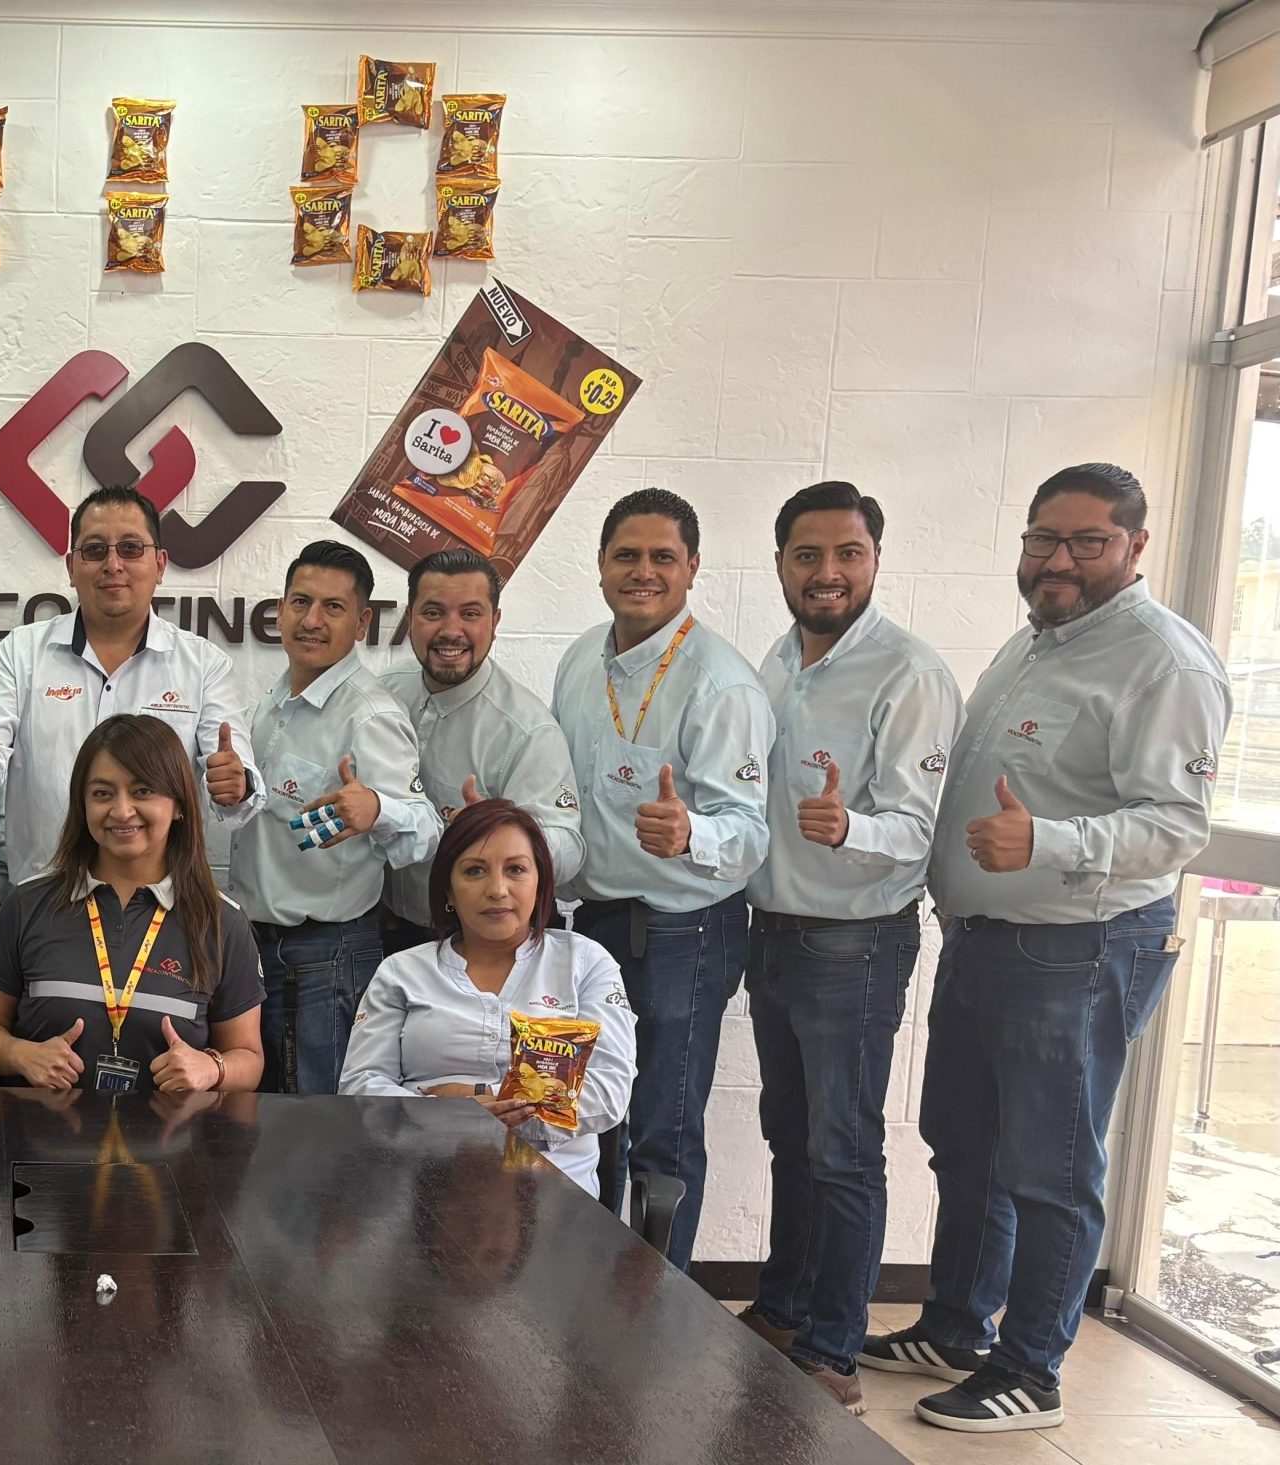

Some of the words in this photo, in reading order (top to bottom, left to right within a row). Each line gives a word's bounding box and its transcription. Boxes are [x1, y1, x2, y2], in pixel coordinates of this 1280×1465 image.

[375, 72, 388, 112] SARITA
[125, 115, 160, 127] SARITA
[318, 116, 351, 127] SARITA
[455, 110, 491, 122] SARITA
[305, 200, 341, 212] SARITA
[451, 195, 487, 207] SARITA
[119, 208, 154, 219] SARITA
[372, 240, 385, 279] SARITA
[487, 286, 517, 327] NUEVO
[599, 373, 617, 390] P.V.P.
[583, 380, 618, 410] $0,25
[488, 391, 545, 441] SARITA
[423, 418, 441, 440] I
[411, 435, 453, 464] Sarita
[368, 486, 386, 504] SABOR
[391, 499, 432, 535] HAMBURGUESA
[430, 529, 441, 540] DE
[372, 507, 397, 528] NUEVA
[396, 517, 417, 537] YORK
[526, 1036, 574, 1059] SARITA
